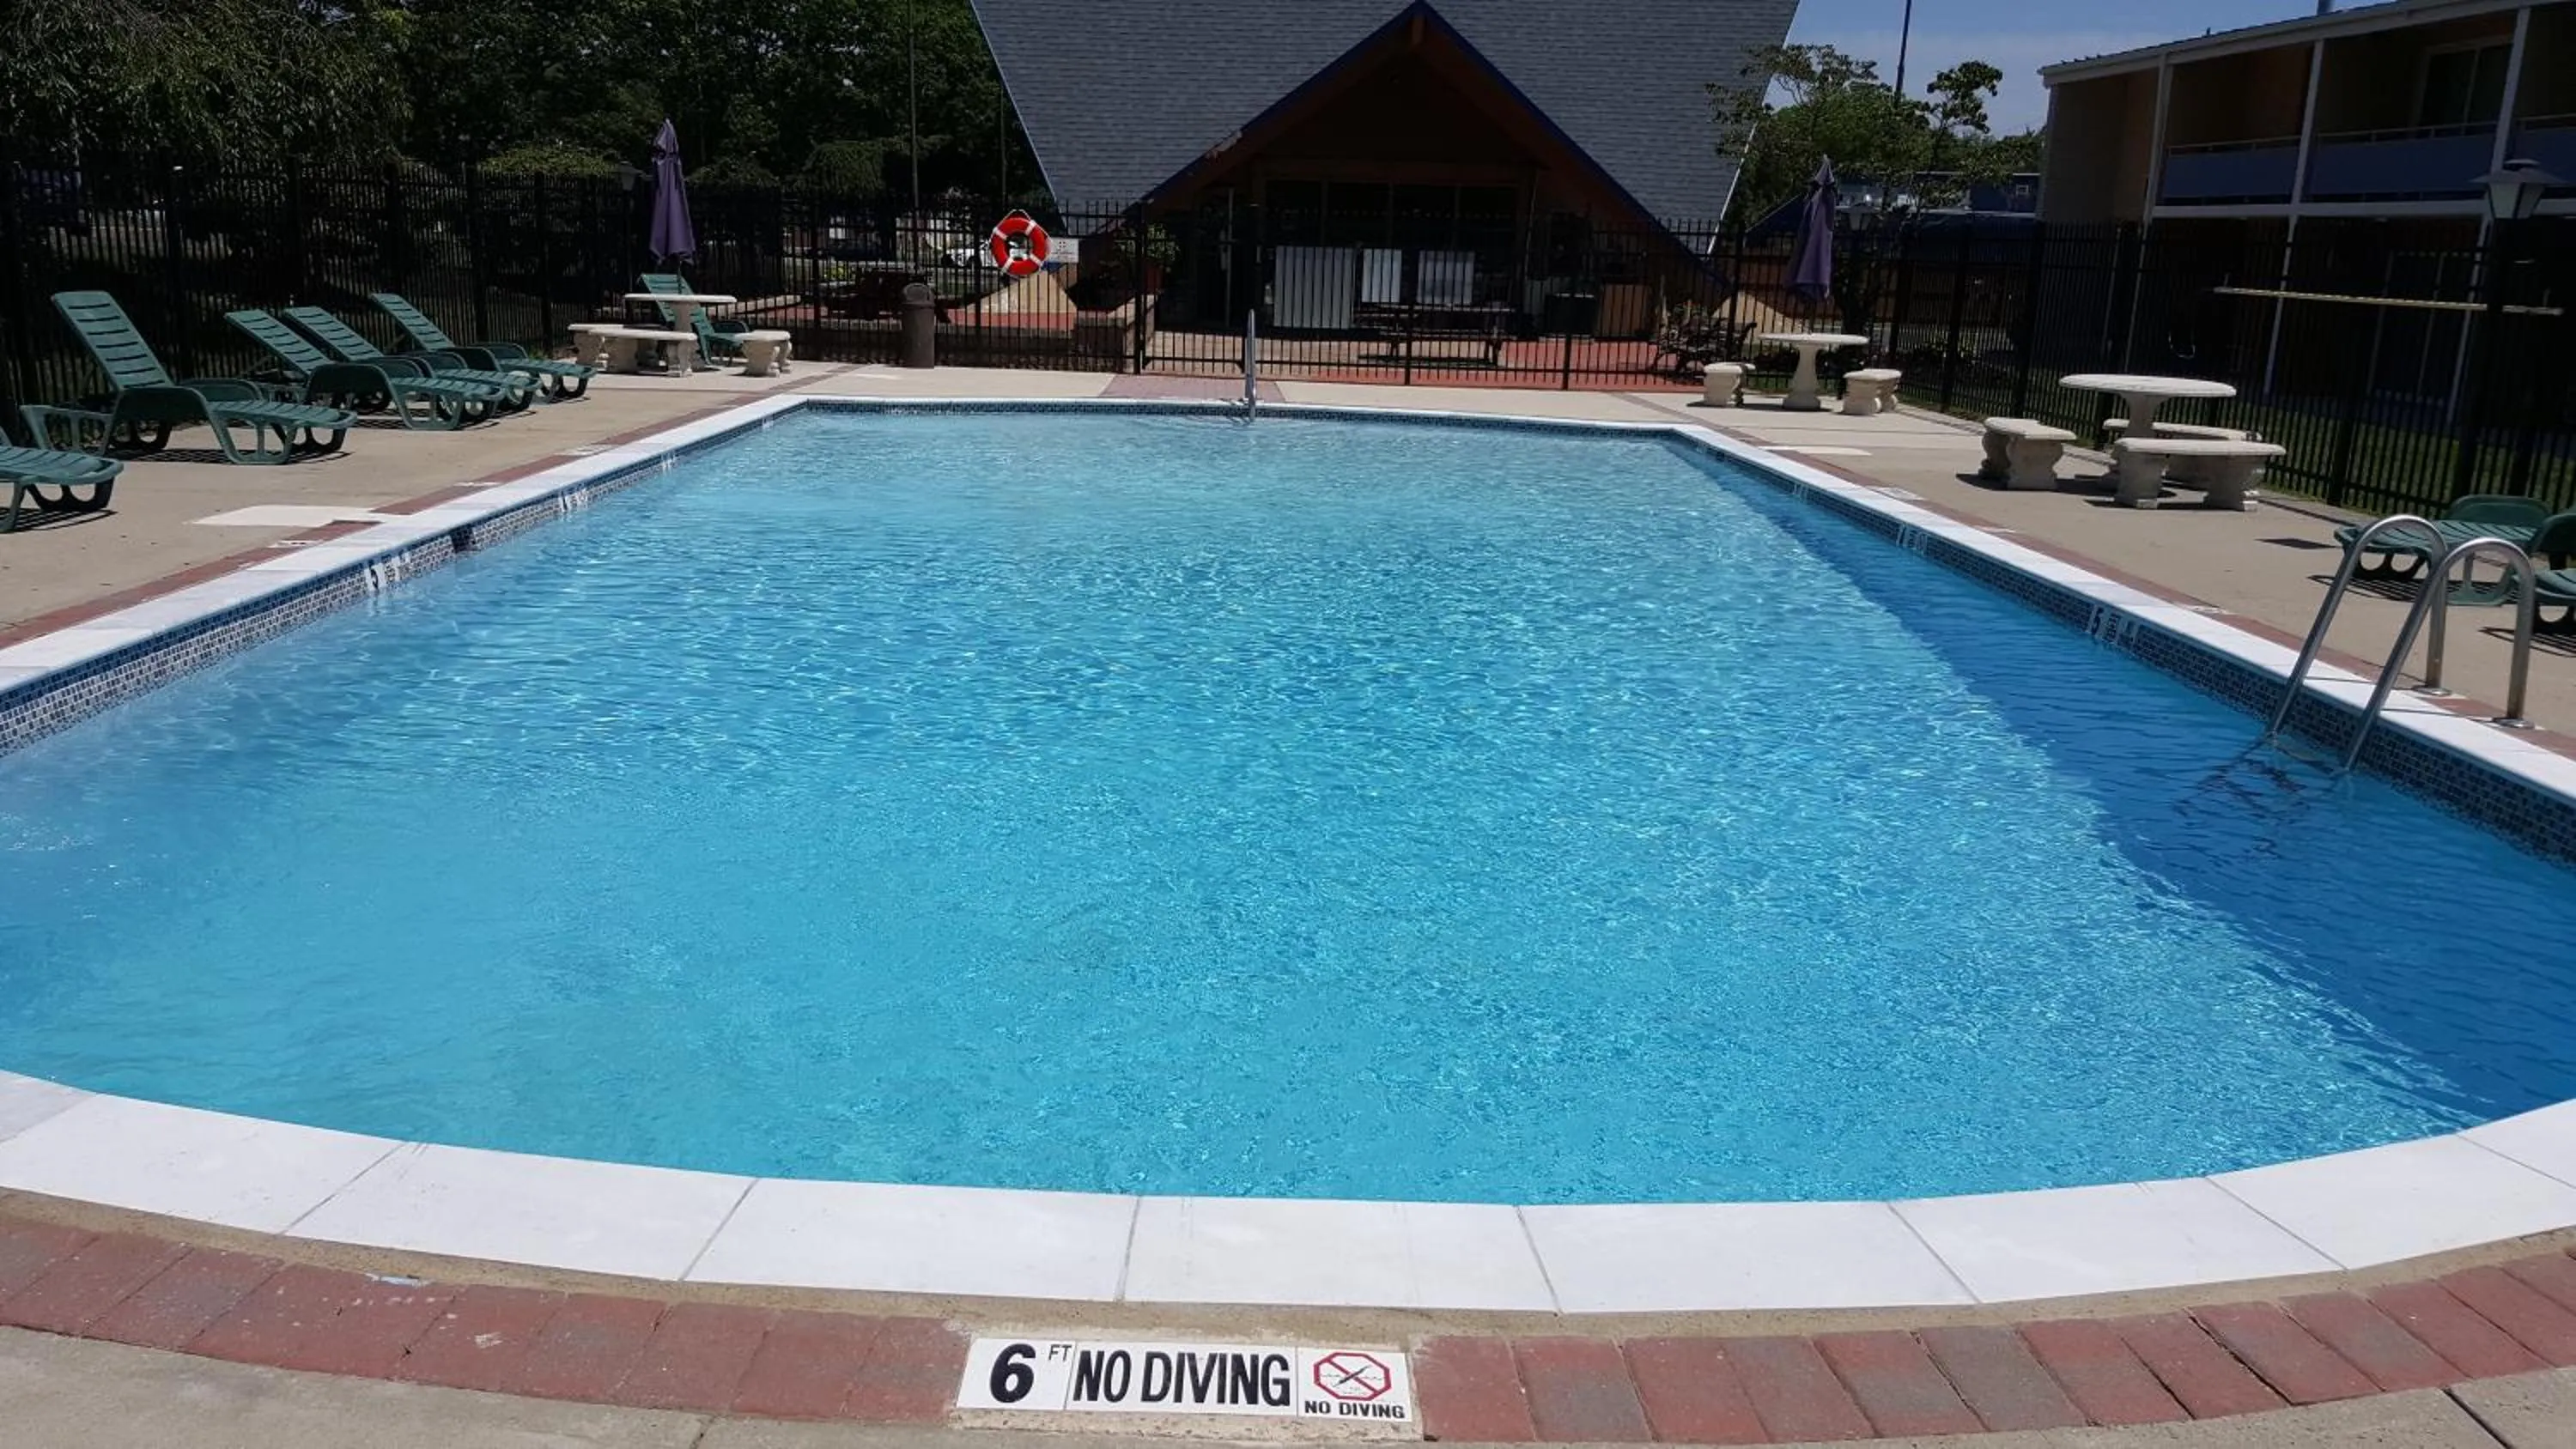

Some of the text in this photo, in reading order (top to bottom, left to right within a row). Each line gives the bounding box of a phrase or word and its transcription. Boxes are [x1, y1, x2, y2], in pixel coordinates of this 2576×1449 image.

[990, 1343, 1072, 1403] 6 FT
[1073, 1349, 1291, 1407] NO DIVING
[1304, 1400, 1405, 1419] NO DIVING
